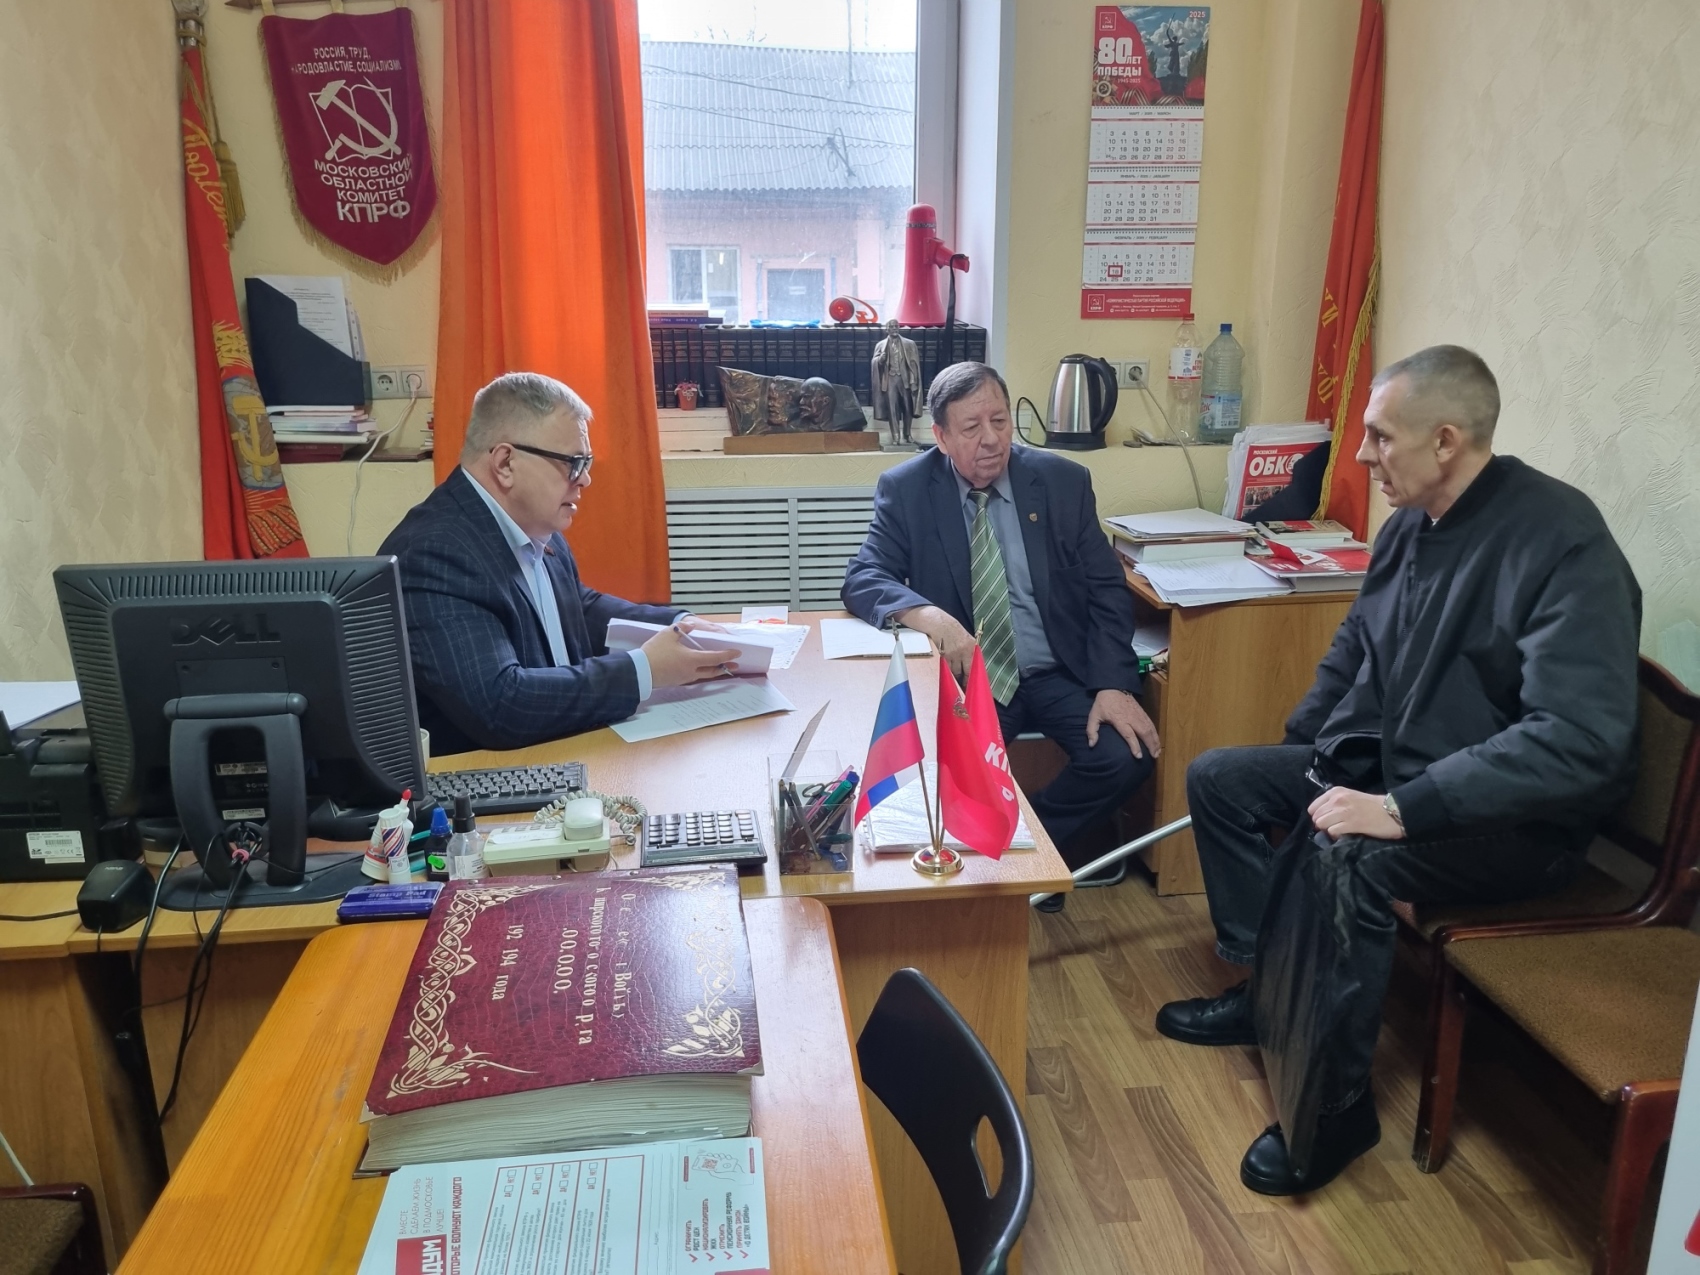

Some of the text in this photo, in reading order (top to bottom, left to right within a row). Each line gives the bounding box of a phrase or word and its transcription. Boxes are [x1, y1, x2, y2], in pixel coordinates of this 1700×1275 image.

[314, 46, 348, 59] РОССИЯ,
[1098, 37, 1142, 64] 80 ЛЕТ
[1098, 66, 1141, 77] ПОБЕДЫ
[314, 153, 412, 177] МОСКОВСКИЙ
[337, 186, 405, 203] КОМИТЕТ
[337, 200, 410, 223] КПРФ
[172, 614, 281, 646] DELL
[492, 975, 508, 1000] года
[423, 1177, 433, 1228] ПОДМОСКОВЬЕ
[399, 1210, 408, 1234] ВМЕСТЕ
[410, 1202, 419, 1234] СДЕЛАЕМ
[451, 1177, 462, 1275] ОТОРЫЕ ВОЛНУЮТ КАЖДОГО
